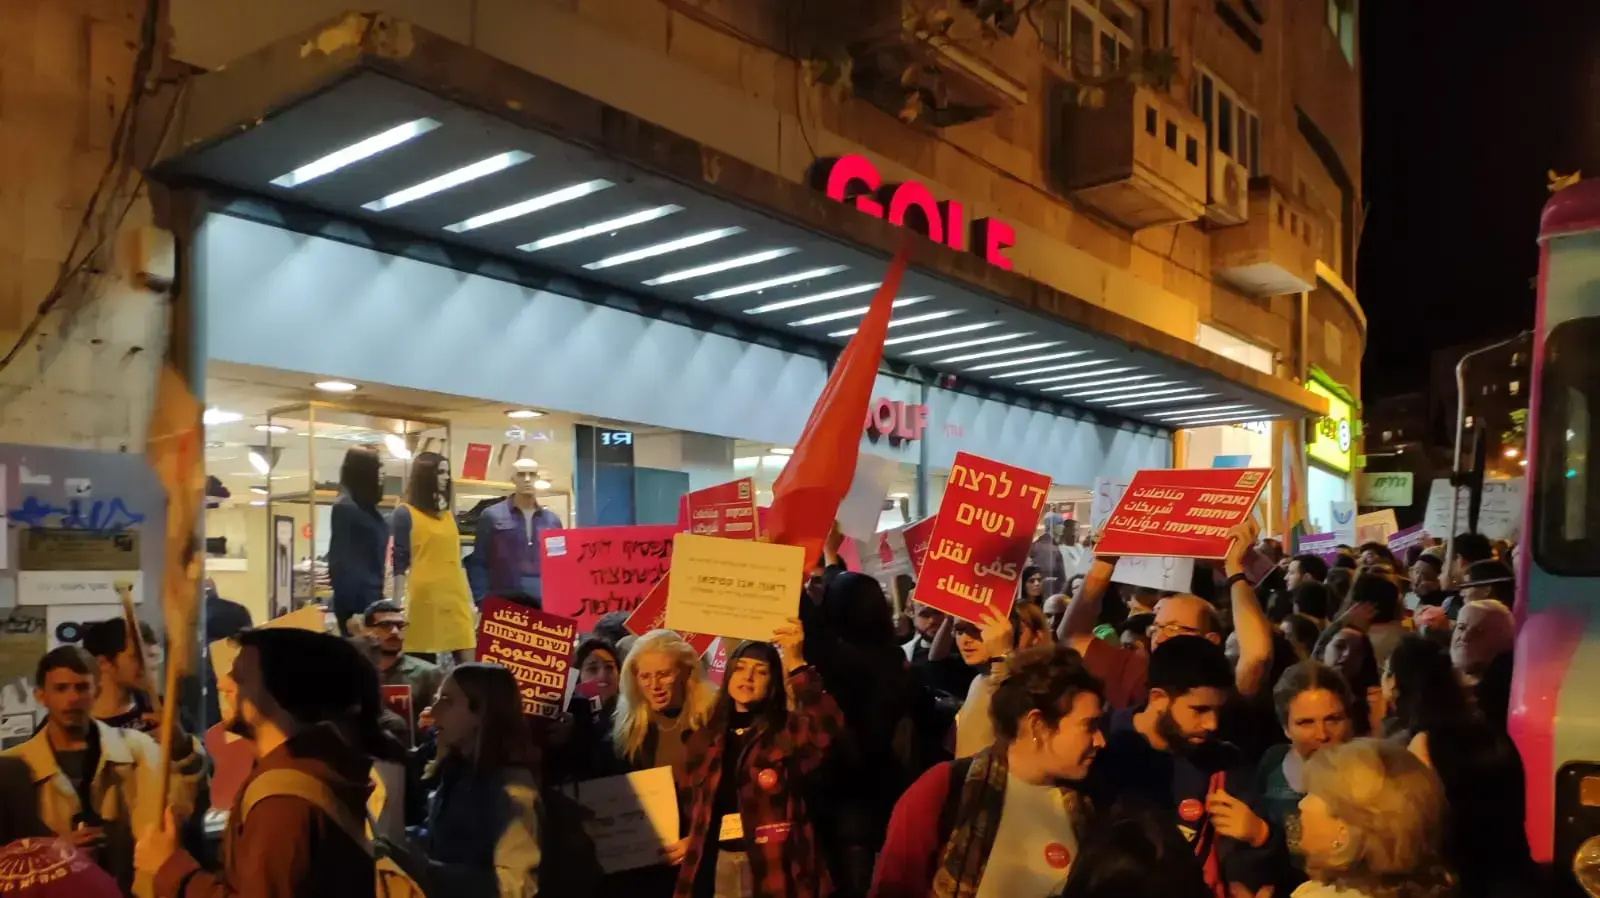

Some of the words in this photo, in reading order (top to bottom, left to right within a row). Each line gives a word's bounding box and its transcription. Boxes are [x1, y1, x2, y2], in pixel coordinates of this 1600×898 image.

[949, 464, 1013, 499] לרצח
[1020, 484, 1046, 510] די
[956, 502, 1015, 538] נשים
[930, 539, 972, 564] لقتل
[974, 556, 1017, 581] كفى
[936, 575, 994, 606] النساء
[485, 622, 532, 644] נרצחות
[536, 638, 568, 653] נשים
[490, 639, 567, 672] والحكومة
